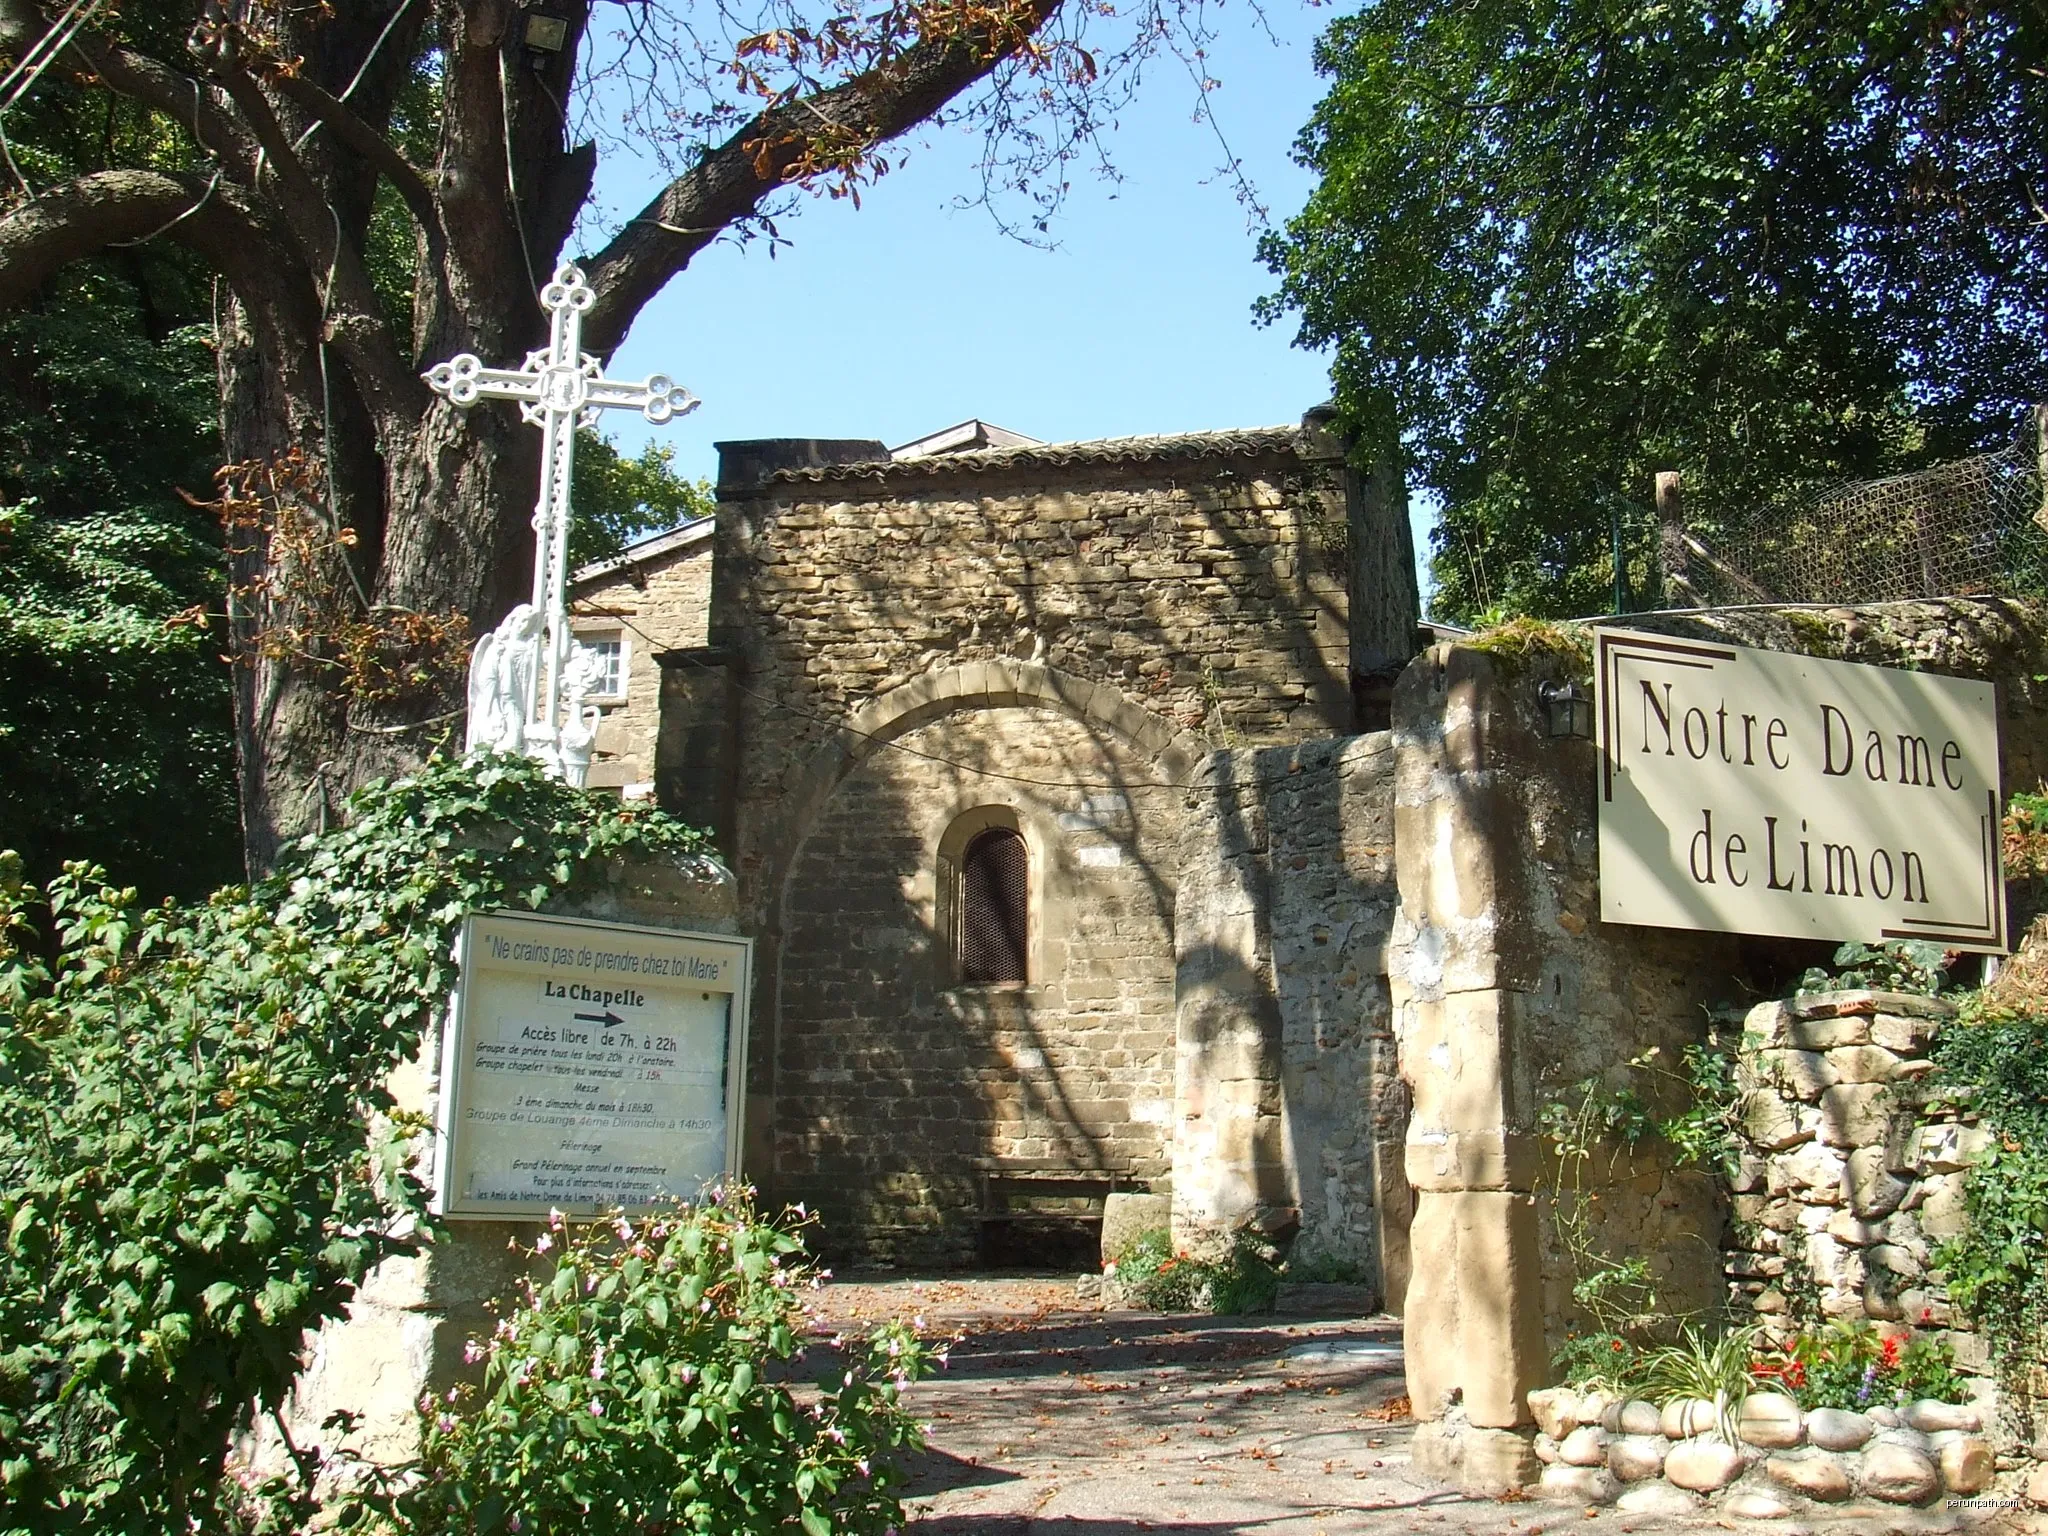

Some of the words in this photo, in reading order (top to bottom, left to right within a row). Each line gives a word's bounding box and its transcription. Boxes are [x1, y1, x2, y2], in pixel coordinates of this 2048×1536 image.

[1639, 680, 1790, 770] Notre
[1820, 704, 1963, 791] Dame
[1690, 809, 1749, 887] de
[1764, 816, 1930, 904] Limon
[513, 939, 550, 962] crains
[552, 946, 574, 968] pas
[578, 945, 592, 968] de
[594, 951, 639, 974] prendre
[642, 953, 669, 976] chez
[672, 956, 686, 976] toi
[544, 981, 566, 998] La
[569, 984, 644, 1008] Chapelle
[520, 1026, 556, 1042] Accès
[562, 1028, 588, 1044] libre
[600, 1032, 614, 1046] de
[620, 1034, 638, 1049] 7h.
[644, 1035, 650, 1050] à
[656, 1037, 676, 1052] 22h
[476, 1042, 506, 1054] Groupe
[508, 1045, 519, 1054] de
[521, 1046, 548, 1057] prière
[551, 1050, 568, 1058] tous
[571, 1049, 582, 1058] les
[586, 1051, 604, 1060] lundi
[608, 1052, 622, 1062] 20h
[476, 1058, 505, 1071] Groupe
[508, 1061, 544, 1072] chapelet
[574, 1082, 600, 1093] Messe
[516, 1096, 523, 1106] 3
[546, 1098, 582, 1110] dimanche
[586, 1101, 595, 1111] du
[598, 1102, 616, 1112] mois
[619, 1102, 624, 1112] à
[466, 1108, 506, 1122] Groupe
[510, 1112, 524, 1122] de
[528, 1112, 576, 1127] Louange
[612, 1117, 666, 1128] Dimanche
[680, 1119, 712, 1130] 14h30
[512, 1159, 539, 1170] Grand
[586, 1162, 610, 1172] annuel
[626, 1166, 667, 1176] septembre
[534, 1176, 549, 1186] Pour
[508, 1190, 518, 1200] de
[520, 1192, 541, 1200] Notre
[544, 1192, 562, 1201] Dame
[564, 1193, 572, 1202] de
